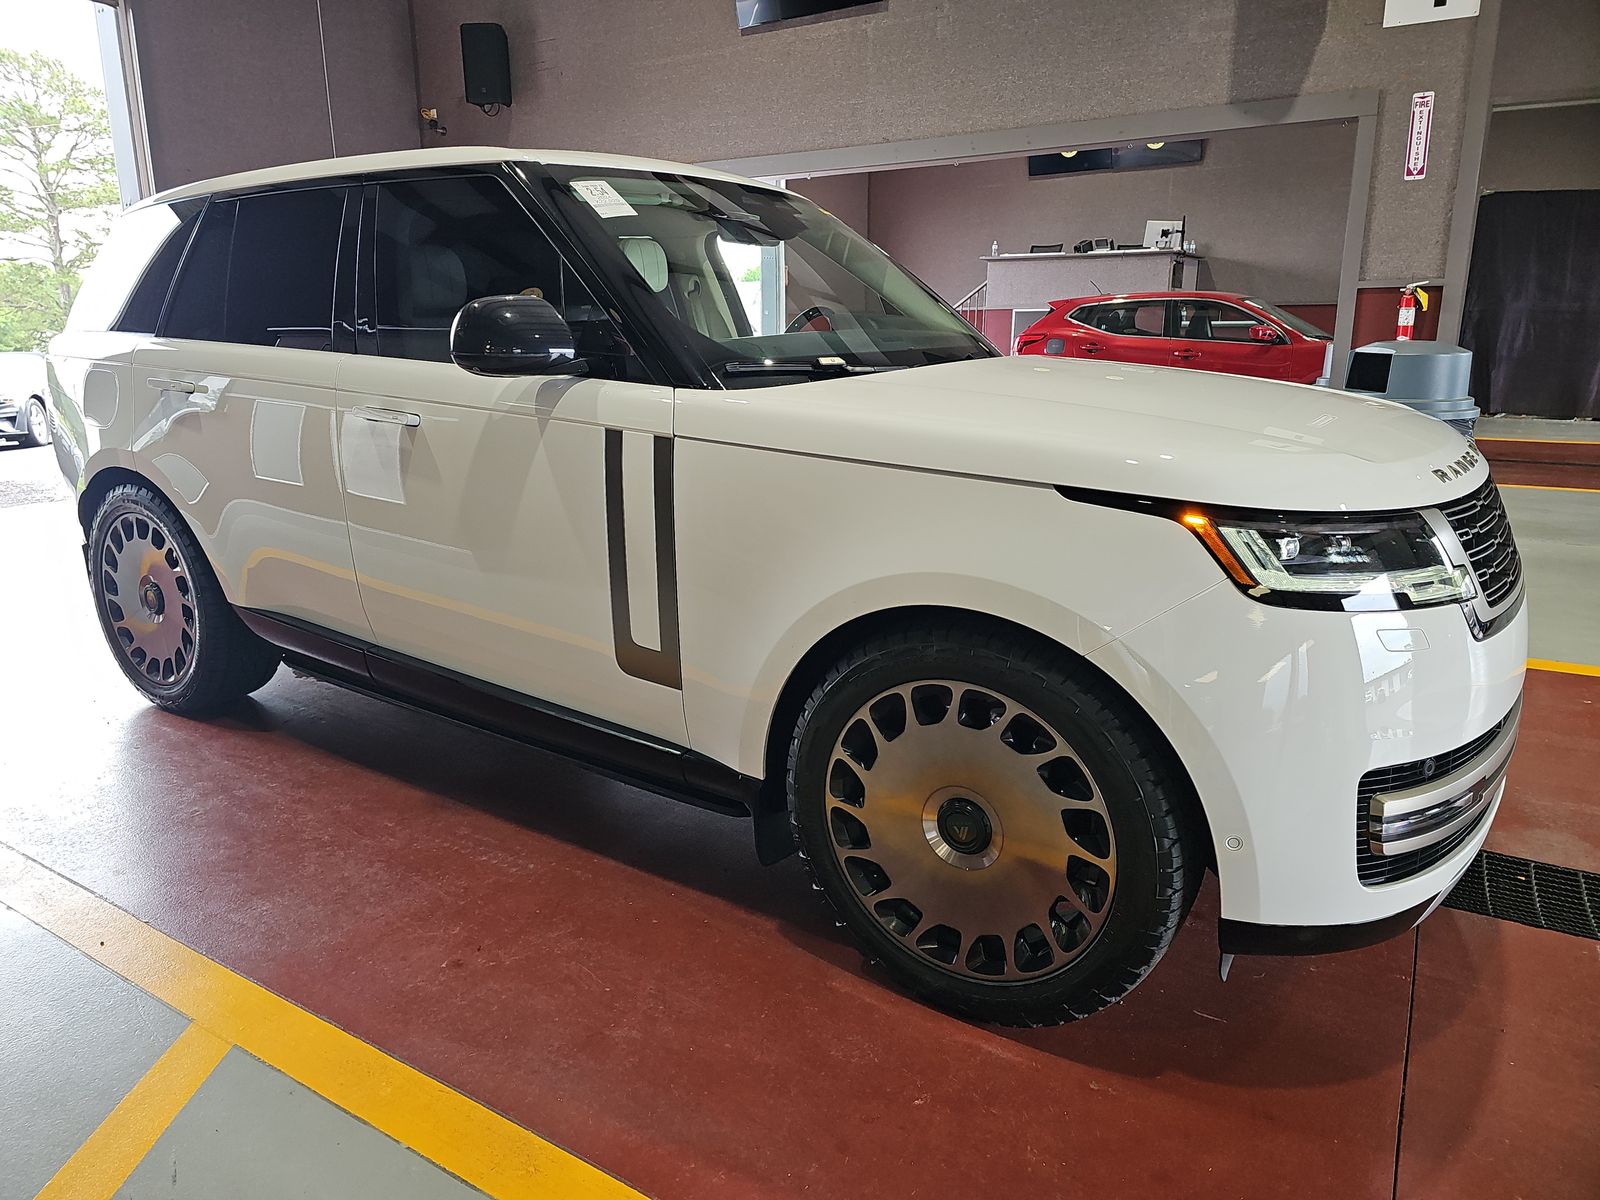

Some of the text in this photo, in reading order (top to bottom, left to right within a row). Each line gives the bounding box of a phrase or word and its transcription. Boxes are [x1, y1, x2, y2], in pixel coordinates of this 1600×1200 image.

[1414, 100, 1430, 109] FIRE
[1413, 110, 1424, 172] EXTINGUISHER
[1431, 451, 1479, 483] RANGE
